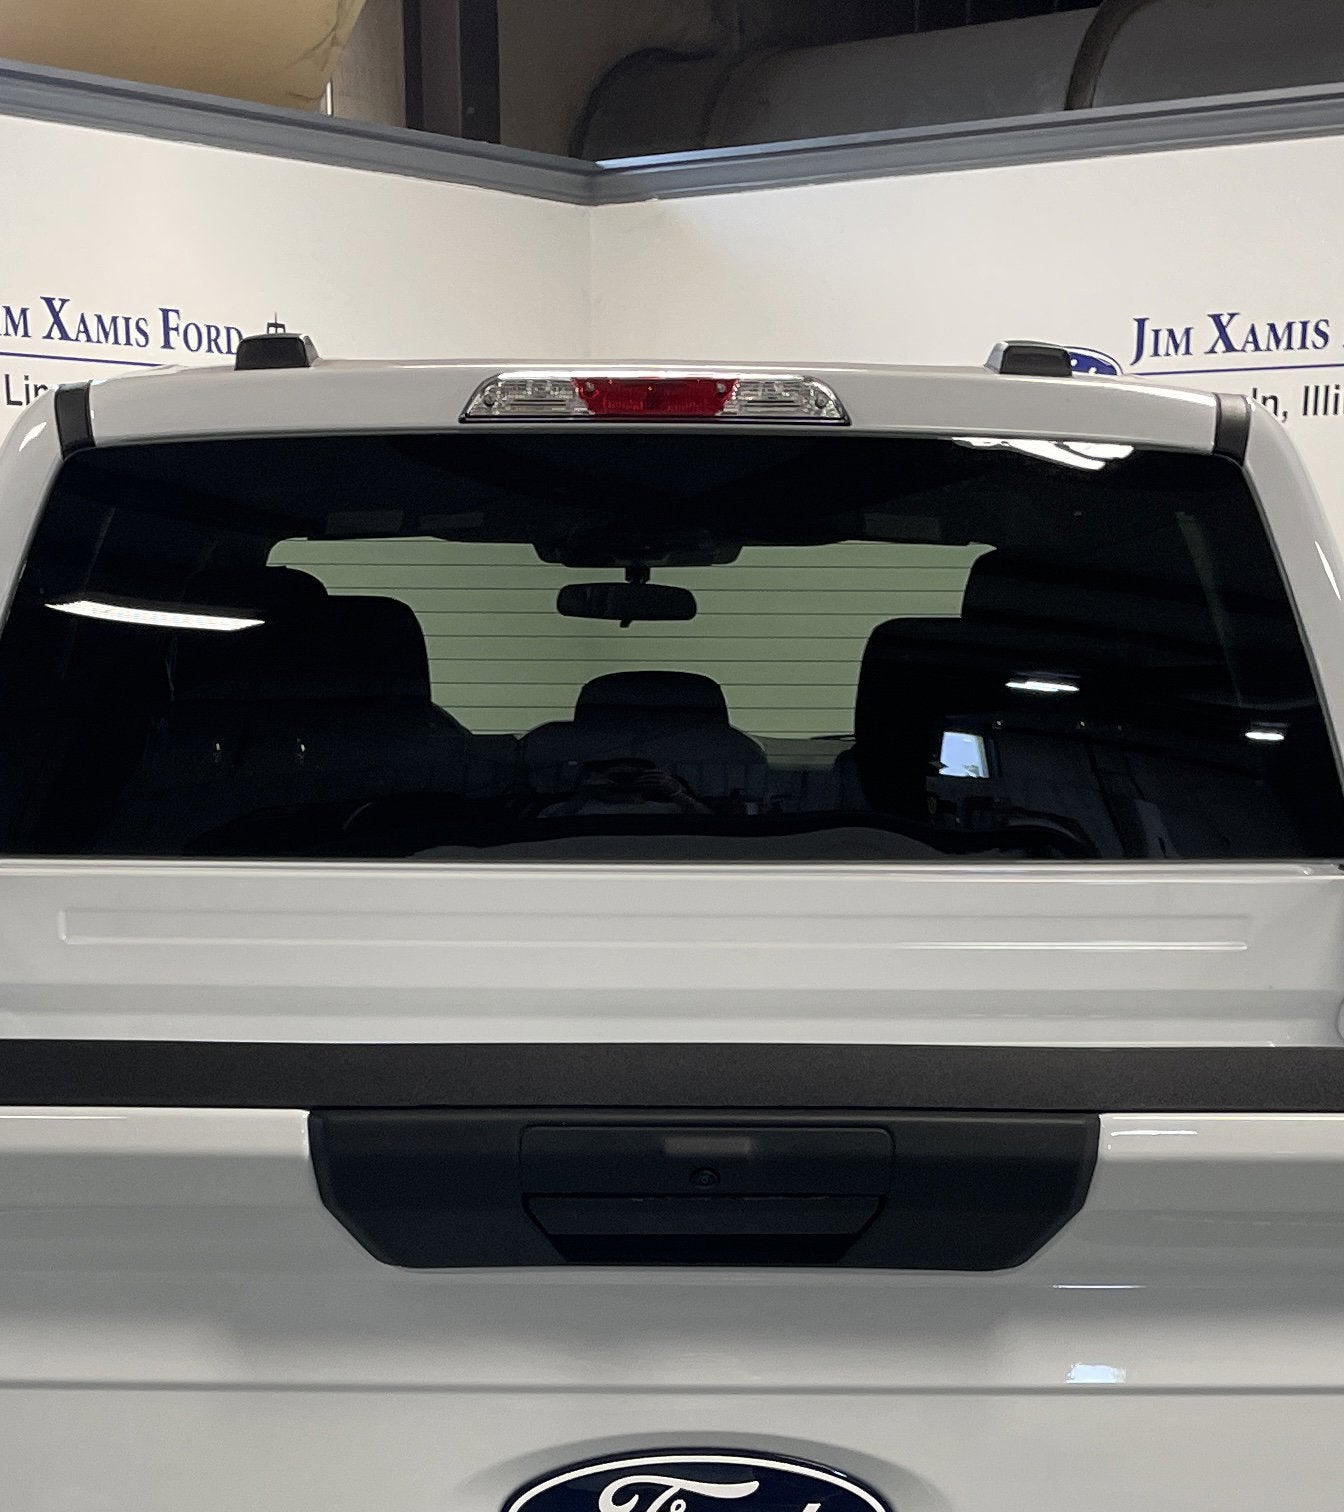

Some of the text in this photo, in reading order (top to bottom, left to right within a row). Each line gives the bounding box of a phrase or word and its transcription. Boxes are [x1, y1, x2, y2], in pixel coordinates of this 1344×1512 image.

[40, 296, 150, 348] XAMIS
[158, 307, 243, 355] FORD
[1130, 317, 1194, 365] JIM
[1204, 312, 1330, 355] XAMIS
